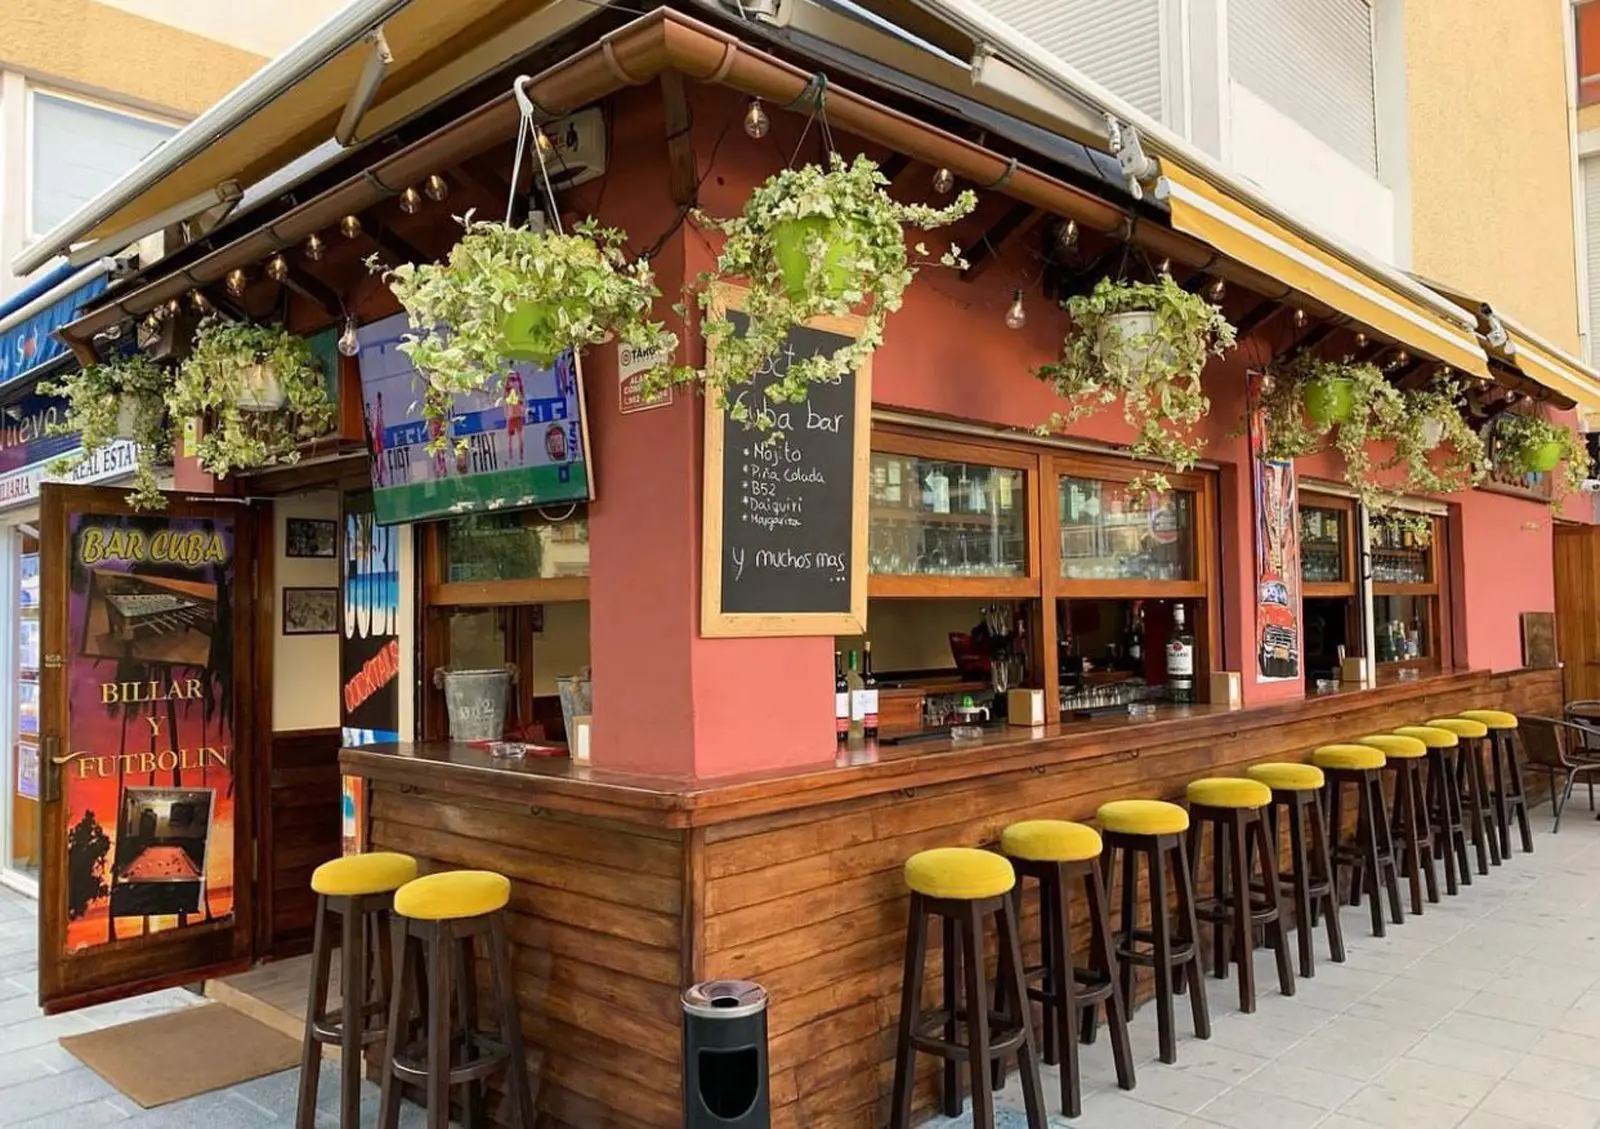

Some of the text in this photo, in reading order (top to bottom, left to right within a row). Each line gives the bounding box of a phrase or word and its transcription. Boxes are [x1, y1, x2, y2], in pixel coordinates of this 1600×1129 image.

[806, 399, 844, 433] bar
[784, 467, 826, 484] Colada
[752, 481, 776, 496] B52
[750, 497, 802, 515] Daiquiri
[83, 529, 225, 565] BAR CUBA
[755, 548, 811, 569] muchos
[816, 552, 845, 572] mas
[101, 679, 203, 704] BILLAR
[145, 715, 166, 737] Y
[77, 746, 229, 779] FUTBOLIN
